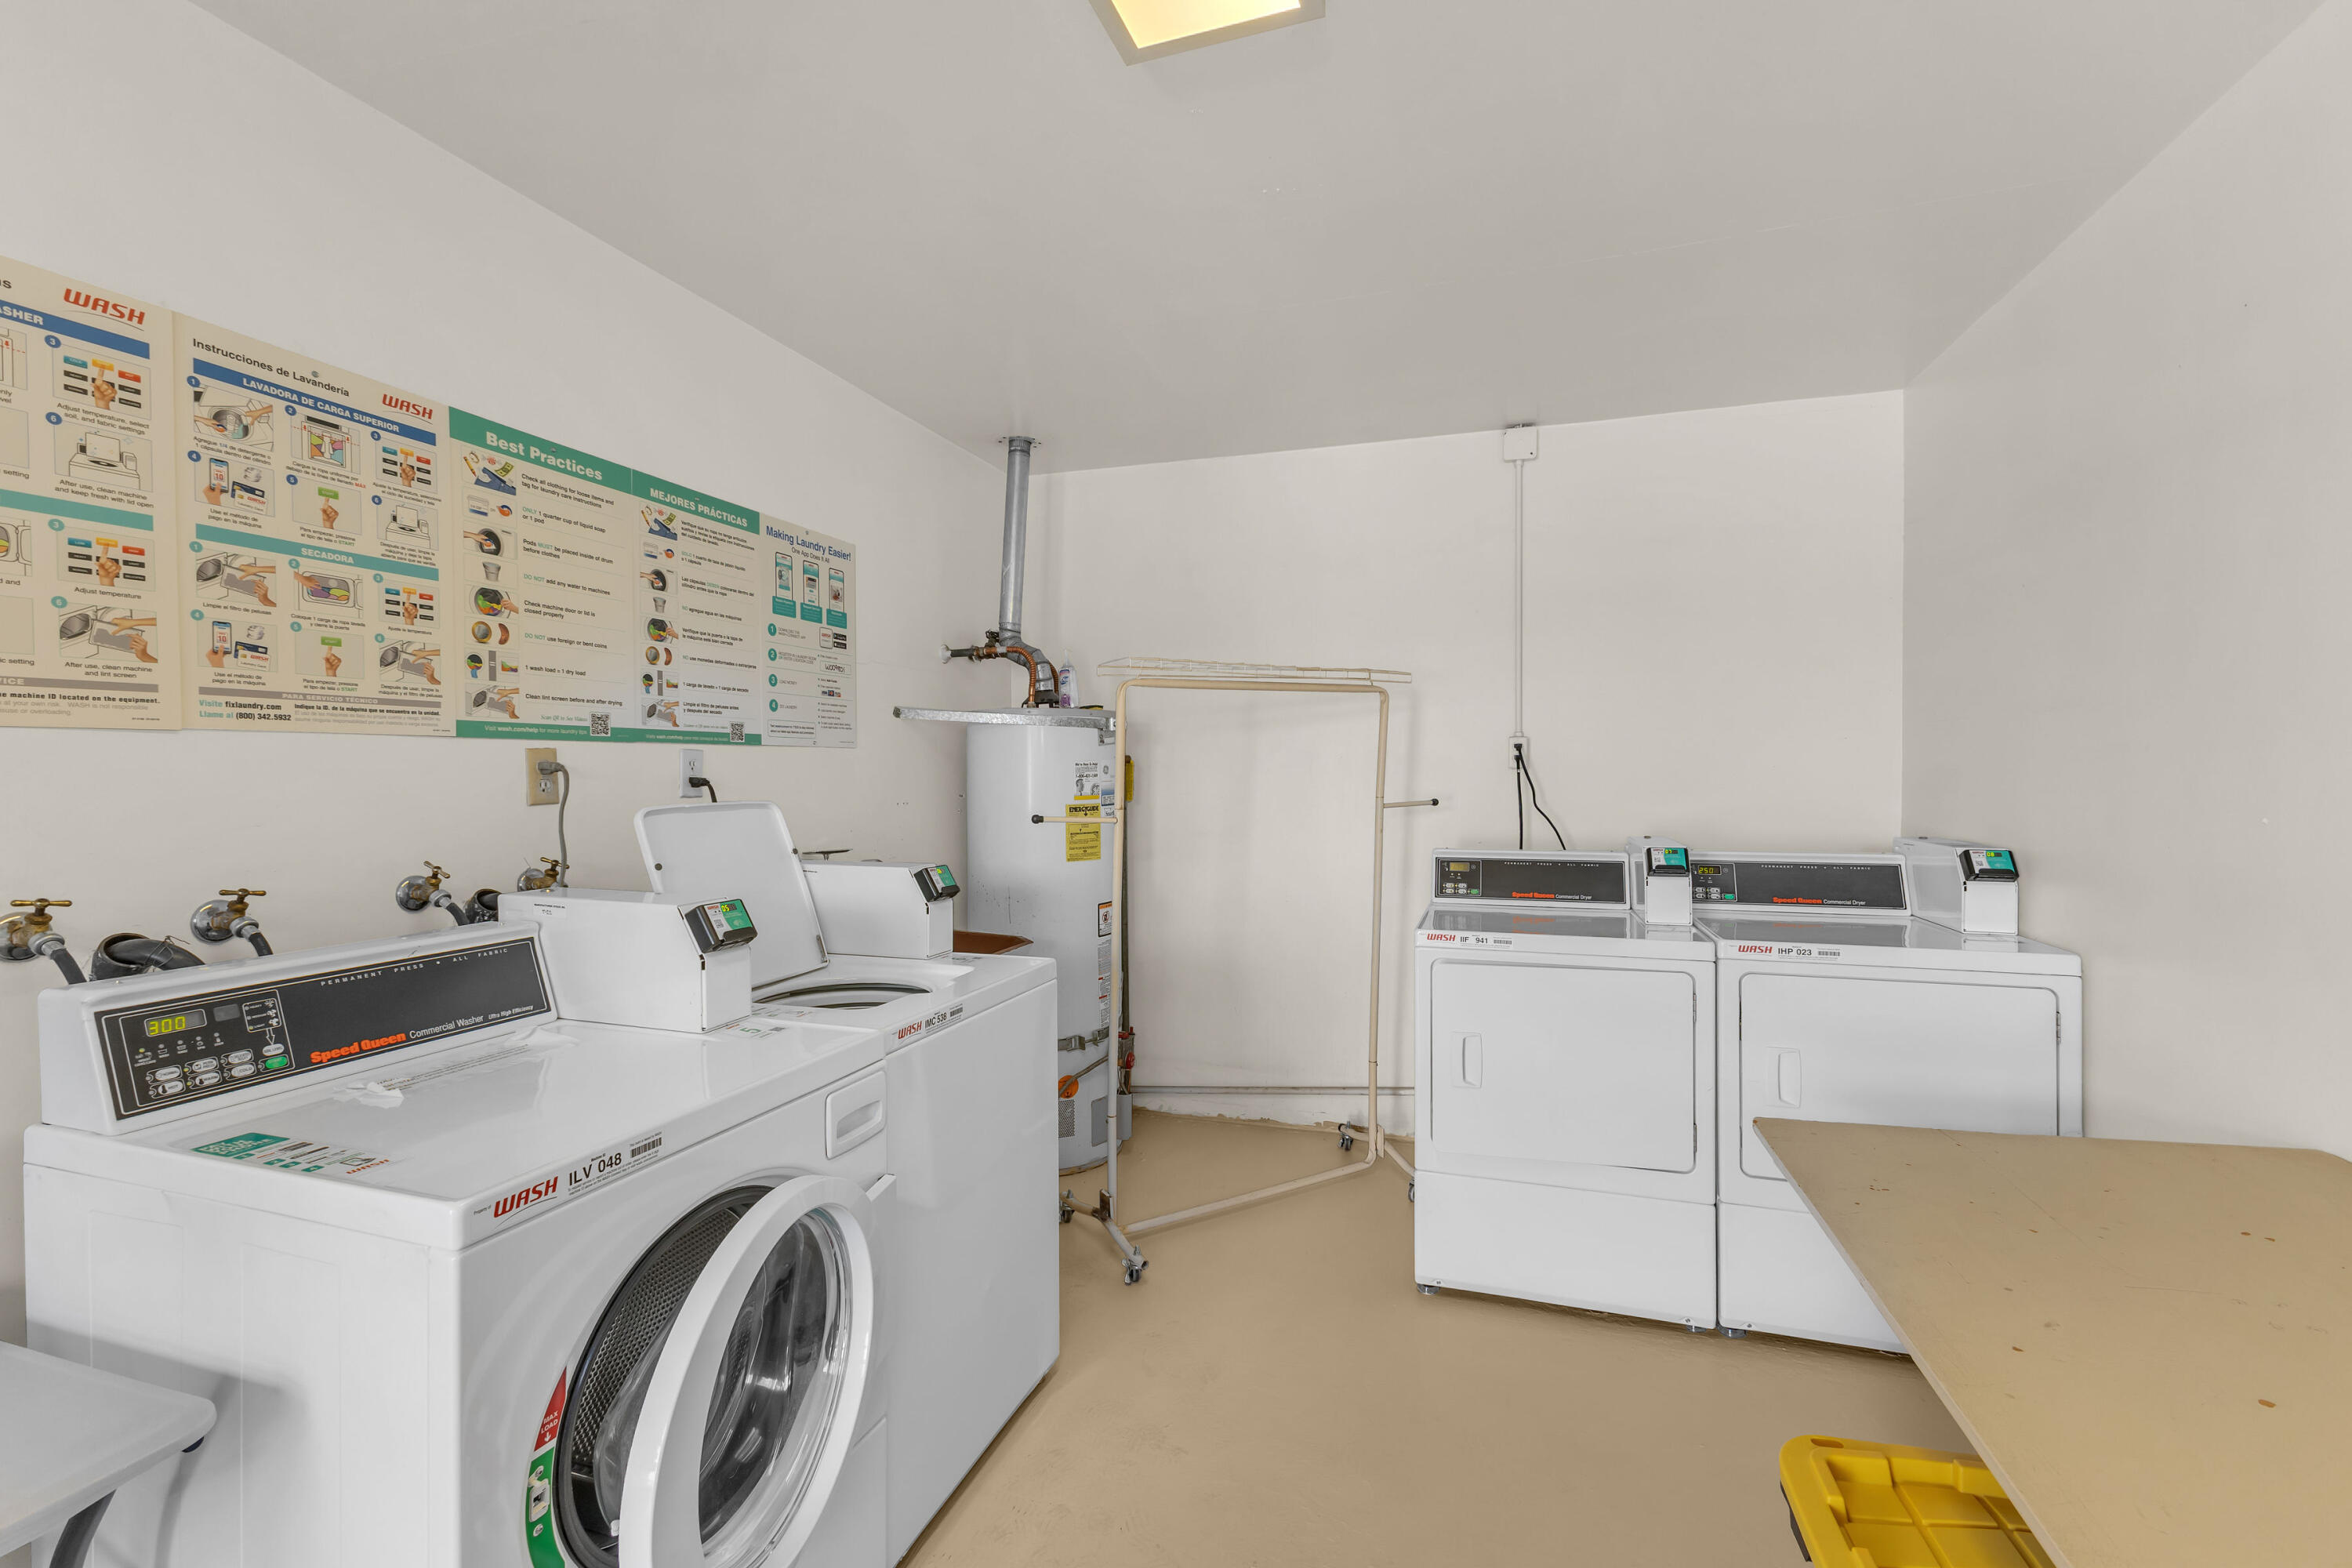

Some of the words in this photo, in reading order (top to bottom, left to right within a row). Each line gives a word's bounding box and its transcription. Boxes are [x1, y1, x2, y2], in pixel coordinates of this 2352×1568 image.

[0, 306, 43, 325] SHER
[64, 288, 145, 325] WASH
[193, 338, 273, 372] Instrucciones
[276, 367, 289, 377] de
[243, 378, 299, 402] LAVADORA
[301, 396, 314, 407] DE
[317, 401, 351, 418] CARGA
[353, 412, 400, 432] SUPERIOR
[383, 394, 433, 420] WASH
[57, 402, 80, 413] Adjust
[129, 419, 149, 429] select
[97, 419, 116, 429] fabric
[118, 425, 145, 435] settings
[485, 431, 525, 456] Best
[529, 445, 602, 481] Practices
[60, 479, 77, 488] After
[118, 490, 147, 500] machine
[71, 488, 89, 497] keep
[91, 492, 109, 500] fresh
[111, 495, 125, 503] with
[521, 474, 538, 484] Check
[547, 480, 568, 493] clothing
[577, 488, 590, 499] loose
[591, 493, 604, 503] items
[541, 485, 560, 497] laundry
[573, 495, 601, 509] instructions
[650, 488, 695, 510] MEJORES
[698, 504, 747, 527] PRÁCTICAS
[535, 517, 545, 525] pod
[543, 512, 561, 522] quarter
[579, 521, 593, 530] liquid
[766, 525, 794, 546] Making
[797, 535, 826, 555] Laundry
[829, 546, 851, 561] Easier!
[301, 547, 354, 564] SECADORA
[523, 546, 540, 555] before
[541, 550, 560, 560] clothes
[562, 547, 579, 557] placed
[579, 550, 593, 559] inside
[74, 586, 97, 596] Adjust
[99, 589, 141, 600] temperature
[588, 586, 610, 595] machines
[524, 600, 541, 608] Check
[542, 602, 564, 612] machine
[543, 611, 564, 619] properly
[225, 701, 281, 710] fixlaundry.com
[307, 694, 343, 702] SERVICIO
[1427, 933, 1455, 942] WASH
[1738, 945, 1773, 954] WASH
[320, 971, 383, 986] PERMANENT
[394, 964, 424, 972] PRESS
[477, 948, 509, 958] FABRIC
[512, 1004, 534, 1014] Efficiency
[149, 1016, 186, 1035] 300
[925, 1017, 935, 1029] IMC
[937, 1012, 947, 1023] 538
[310, 1041, 360, 1063] Speed
[361, 1033, 406, 1051] Queen
[409, 1021, 456, 1040] Commercial
[456, 1014, 484, 1029] Washer
[898, 1021, 922, 1039] WASH
[568, 1163, 592, 1186] ILV
[597, 1152, 622, 1173] 048
[493, 1176, 559, 1218] WASH
[544, 1410, 558, 1424] MAX
[541, 1419, 558, 1434] LOAD
